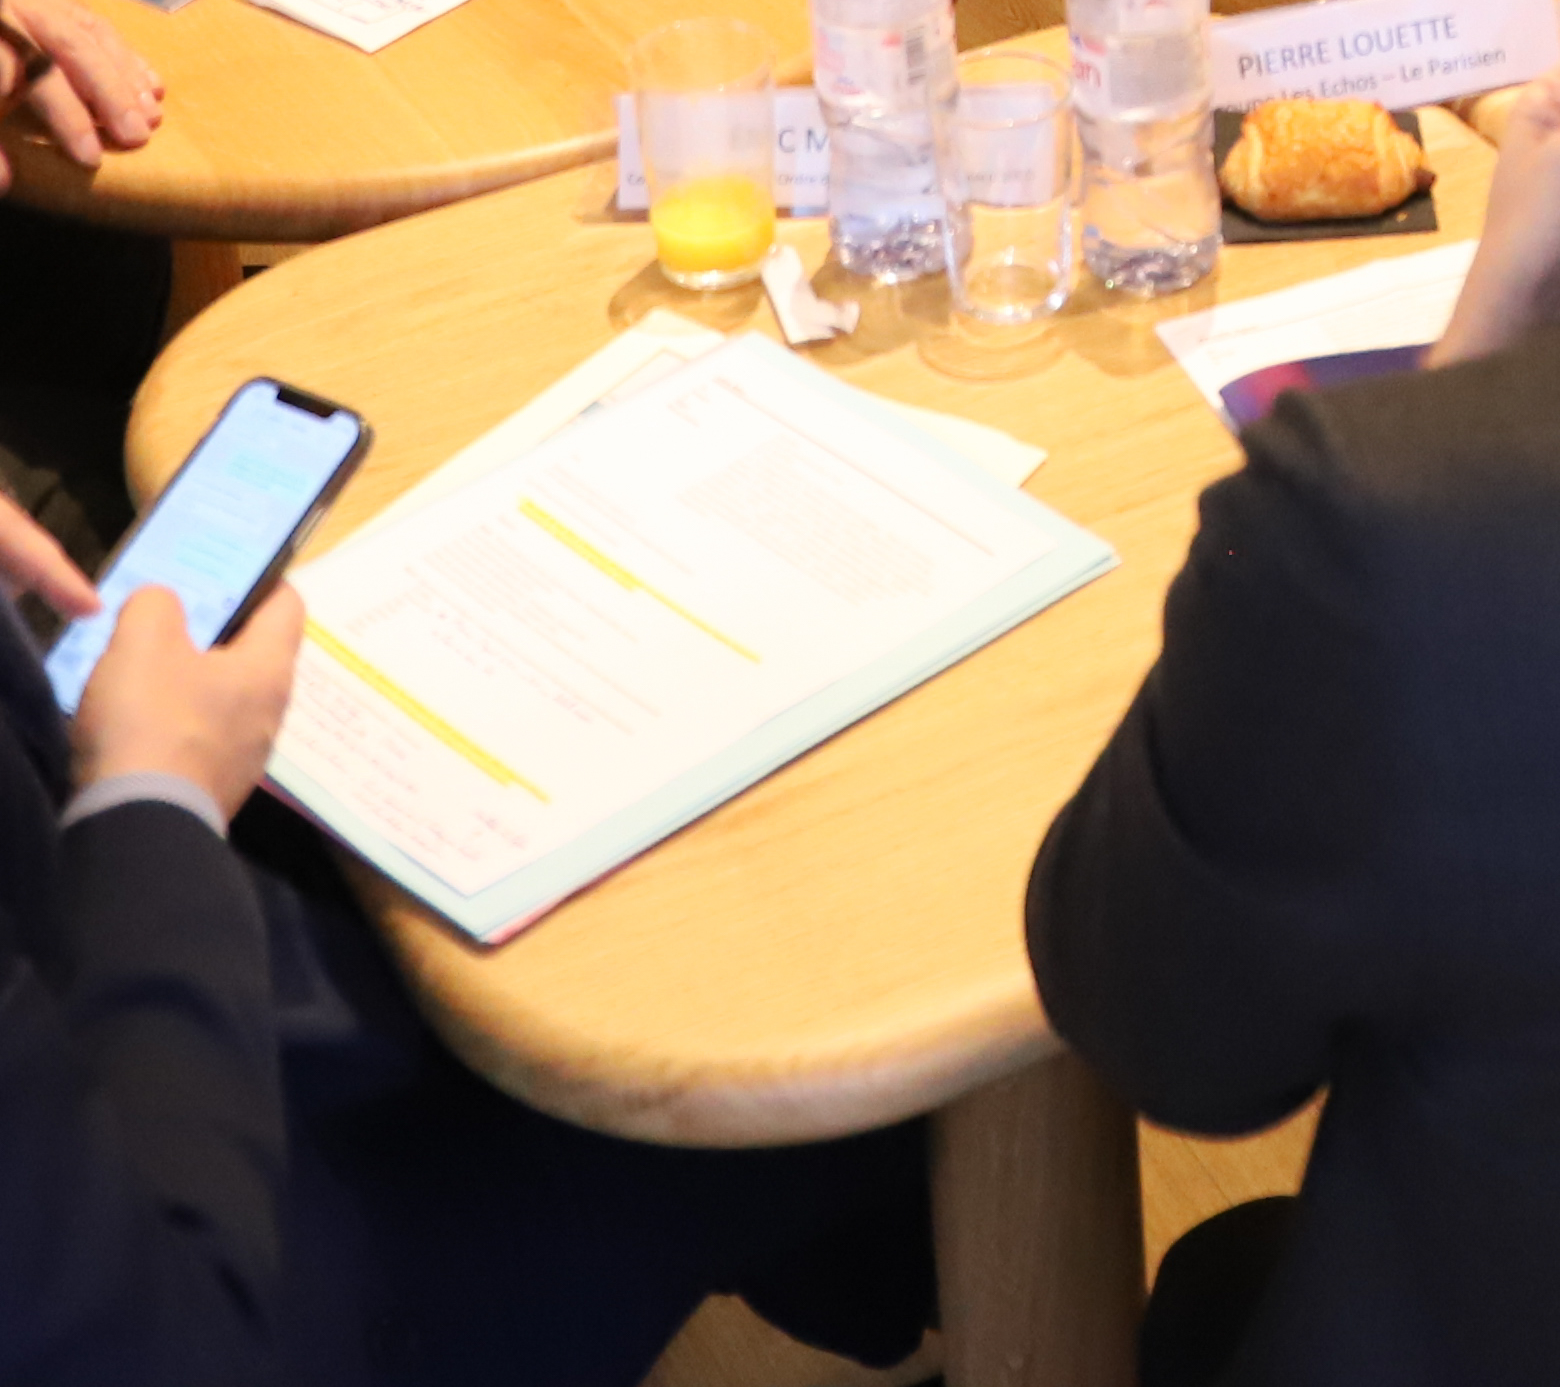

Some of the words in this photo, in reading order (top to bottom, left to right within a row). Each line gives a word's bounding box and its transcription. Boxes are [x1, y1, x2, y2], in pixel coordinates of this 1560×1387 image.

[1238, 37, 1332, 80] PIERRE
[1338, 13, 1459, 61] LOUETTE
[1400, 63, 1423, 83] Le
[1429, 46, 1507, 77] Parisien
